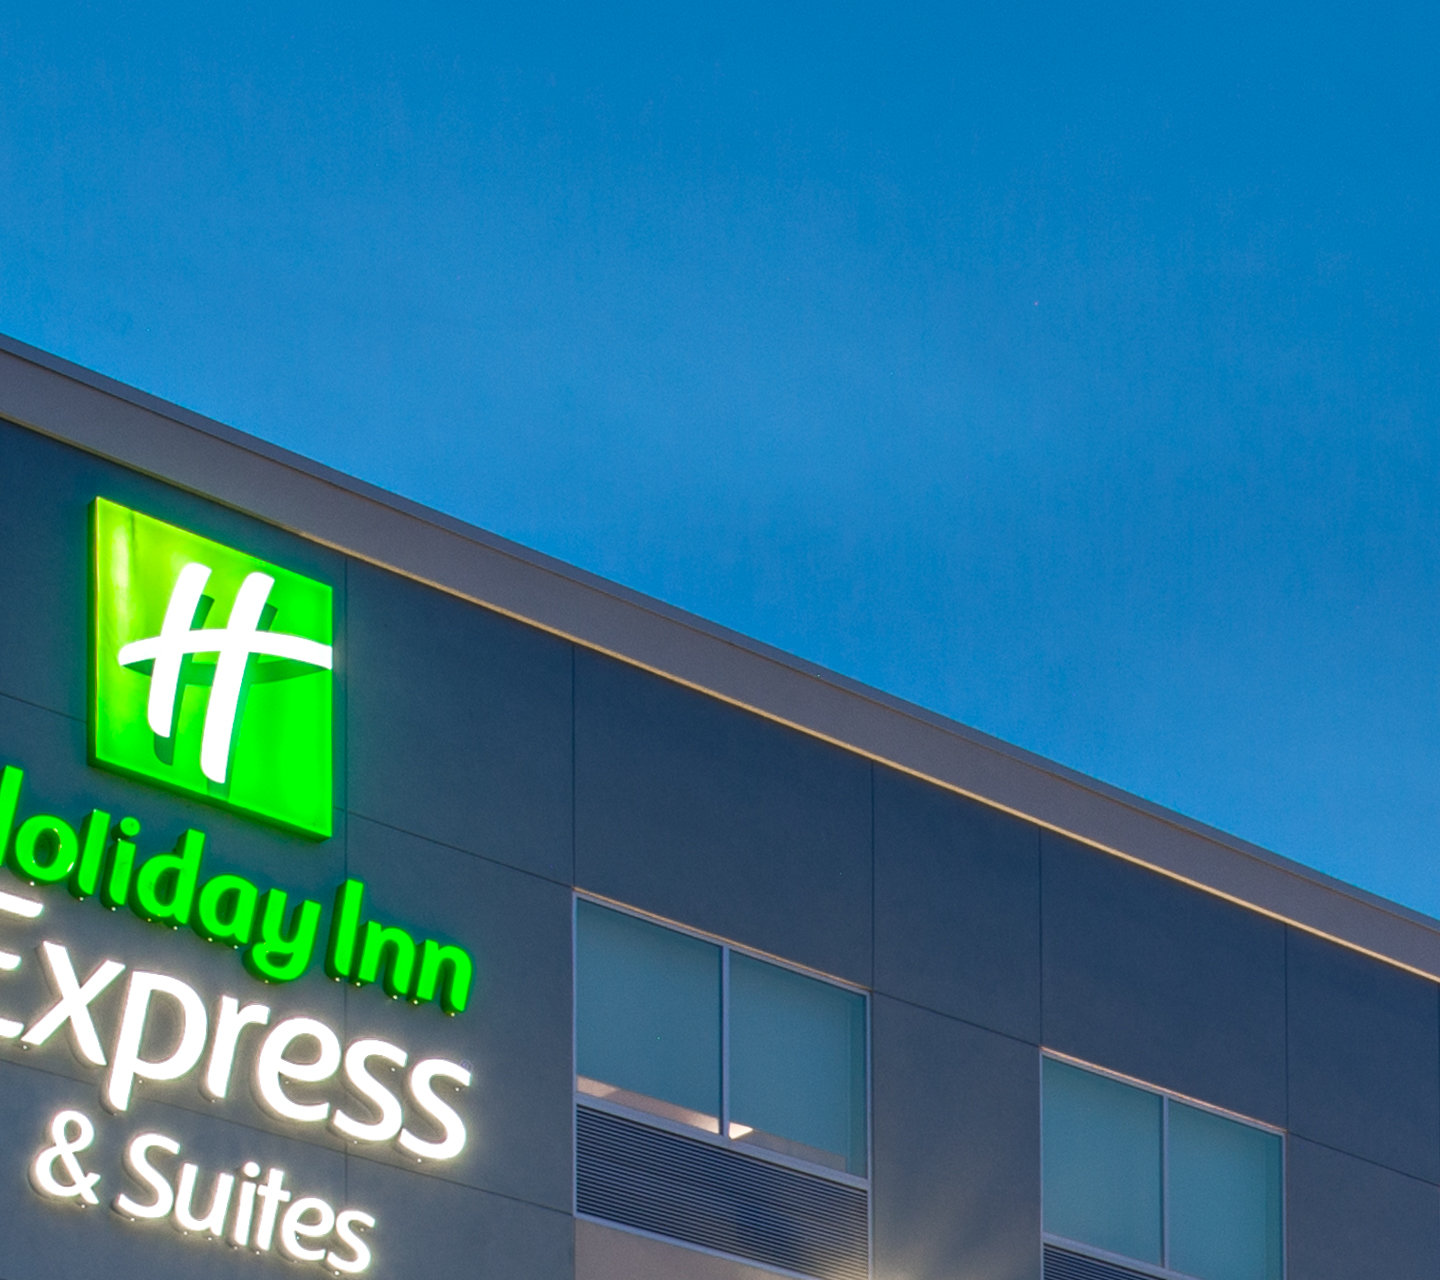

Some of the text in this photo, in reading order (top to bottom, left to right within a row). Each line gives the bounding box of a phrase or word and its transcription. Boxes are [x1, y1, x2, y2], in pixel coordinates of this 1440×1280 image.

[333, 880, 474, 1013] Inn
[31, 1110, 377, 1274] & Suites
